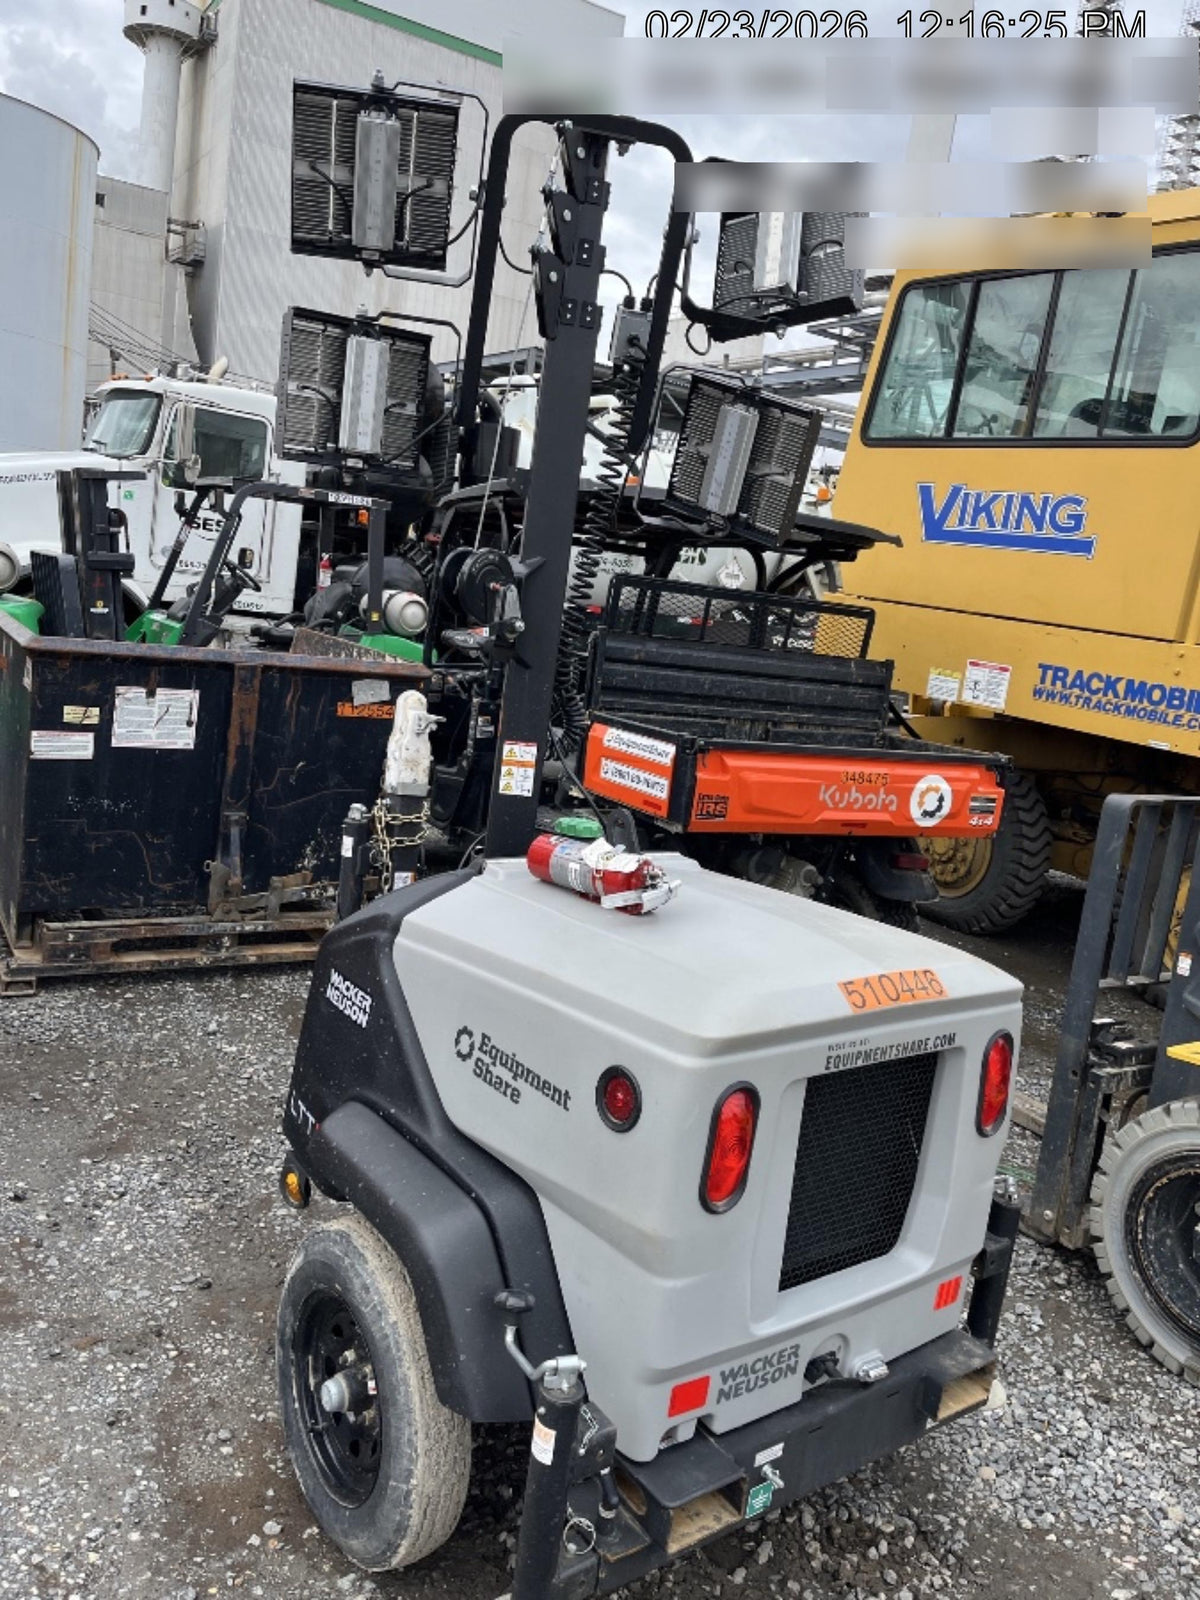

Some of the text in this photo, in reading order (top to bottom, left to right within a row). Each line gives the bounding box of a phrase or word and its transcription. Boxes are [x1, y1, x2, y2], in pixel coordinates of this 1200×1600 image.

[917, 482, 1096, 560] VIKING
[1033, 684, 1200, 731] WWW.TRACKMOBILE.C
[819, 784, 898, 812] Kubota
[841, 771, 890, 787] 348475
[326, 983, 369, 1028] NEUSON
[330, 968, 372, 1013] WACKER
[843, 968, 944, 1009] 510446
[478, 1031, 572, 1113] Equipment
[824, 1032, 957, 1071] EQUIPMENTSHARE.COM
[473, 1057, 522, 1105] Share
[716, 1360, 799, 1404] NEUSON
[719, 1344, 801, 1386] WACKER
